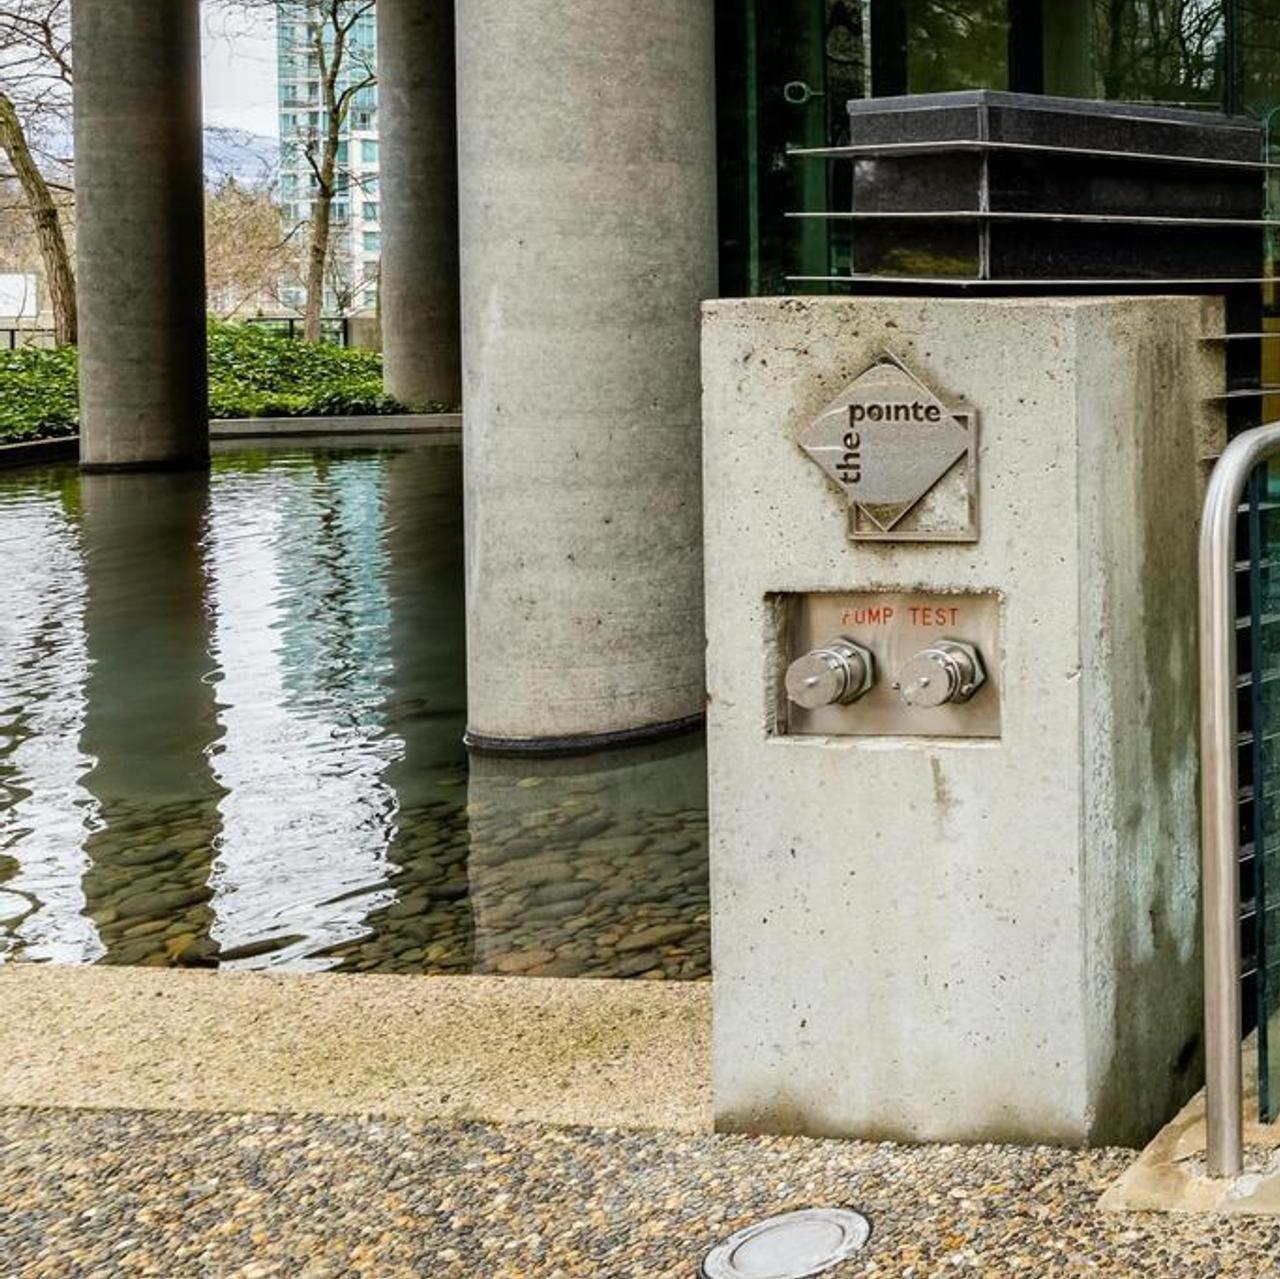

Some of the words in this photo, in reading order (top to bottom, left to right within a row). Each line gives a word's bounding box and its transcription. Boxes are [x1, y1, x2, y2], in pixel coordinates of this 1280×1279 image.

[848, 401, 941, 428] pointe
[835, 432, 861, 484] the
[909, 607, 959, 626] TEST
